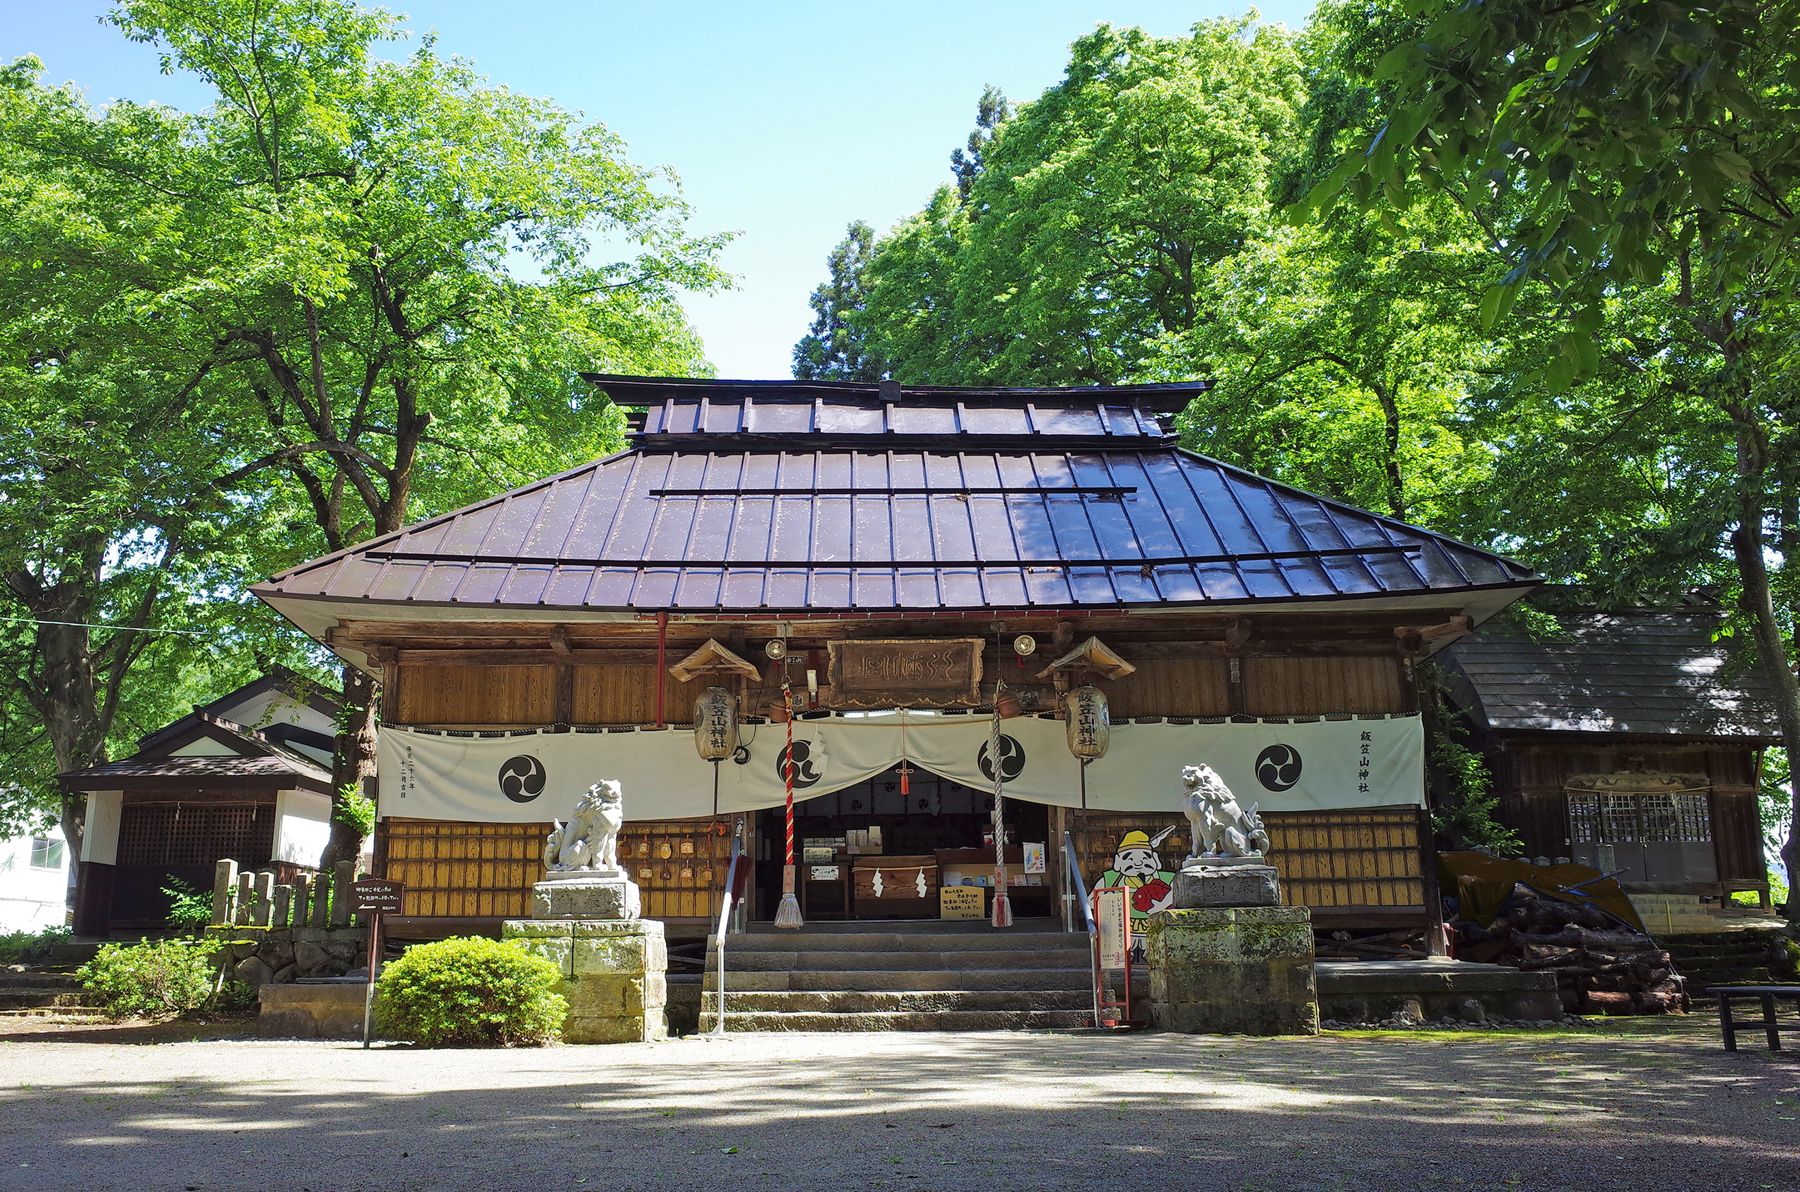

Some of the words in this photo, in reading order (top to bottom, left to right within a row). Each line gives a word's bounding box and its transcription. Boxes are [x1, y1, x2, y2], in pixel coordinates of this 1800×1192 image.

[710, 694, 728, 748] 飯笠山神社
[1078, 693, 1097, 746] 飯笠山神社
[1358, 731, 1371, 793] 飯笠山神社
